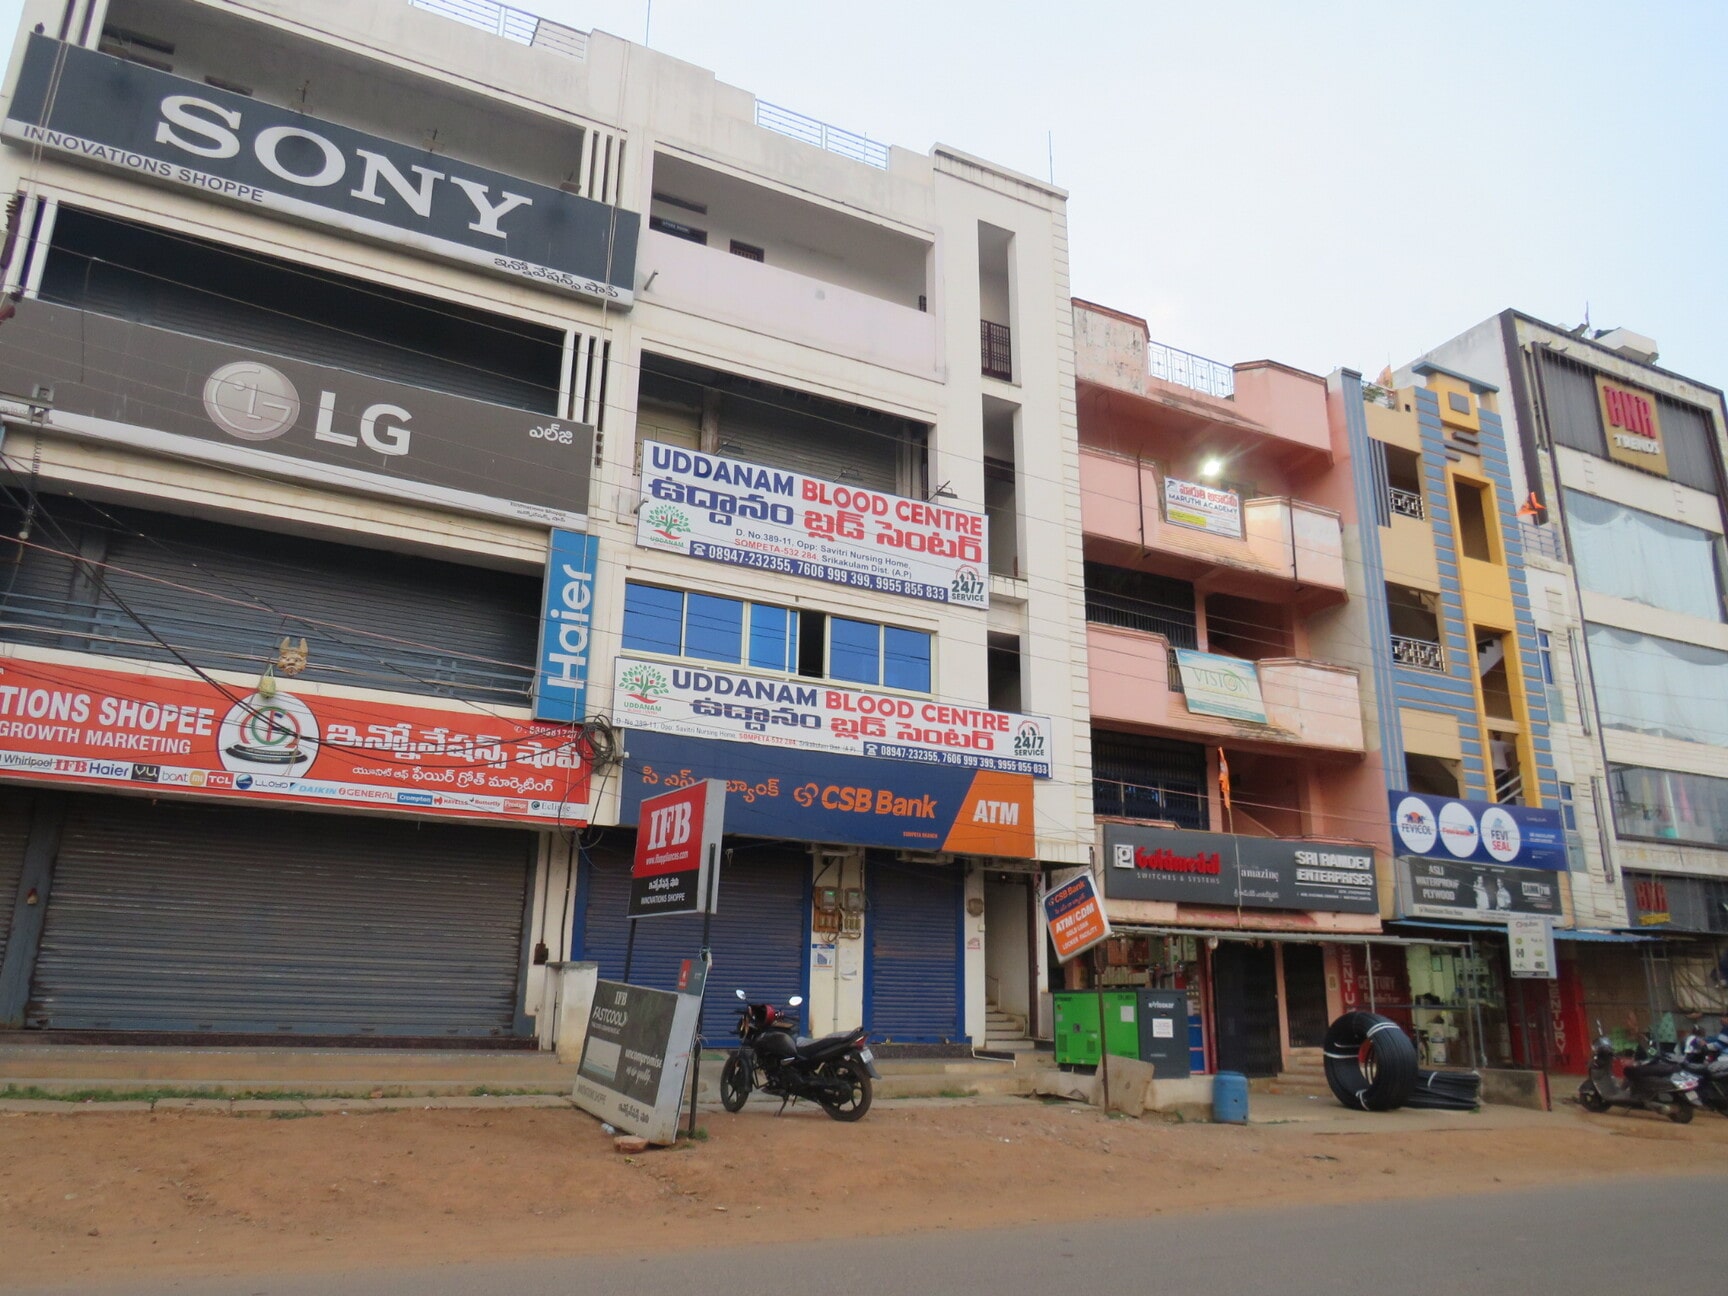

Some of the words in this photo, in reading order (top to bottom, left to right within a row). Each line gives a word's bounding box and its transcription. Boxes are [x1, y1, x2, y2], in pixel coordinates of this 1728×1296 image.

[23, 124, 172, 177] INNOVATIONS
[178, 168, 264, 203] SHOPPE
[156, 94, 533, 239] SONY
[315, 390, 413, 456] LG
[652, 445, 794, 497] UDDANAM
[801, 478, 889, 517] BLOOD
[895, 500, 983, 537] CENTRE
[1168, 493, 1202, 506] MARUTHI
[1203, 501, 1238, 514] ACADEMY
[648, 476, 794, 526] ఉద్దానం
[803, 510, 865, 542] బ్లడ్
[875, 519, 982, 564] సెంటర్
[736, 528, 745, 537] D.
[797, 540, 818, 552] Opp:
[820, 544, 848, 557] Savitri
[851, 550, 883, 566] Nursing
[708, 545, 794, 574] 08947-232355,
[798, 561, 824, 578] 7606
[828, 567, 847, 583] 999
[850, 572, 873, 589] 399,
[876, 578, 902, 594] 9955
[904, 585, 923, 597] 855
[926, 588, 945, 601] 833
[822, 555, 869, 571] Srikakulam
[871, 564, 890, 575] Dist.
[892, 568, 912, 580] (A.P)
[951, 580, 984, 595] 24/7
[951, 592, 984, 602] SERVICE
[547, 563, 592, 690] Haier
[0, 685, 91, 723] TIONS
[98, 697, 215, 736] SHOPEE
[623, 701, 662, 712] UDDANAM
[673, 669, 818, 707] UDDANAM
[825, 690, 914, 719] BLOOD
[921, 703, 1010, 732] CENTRE
[675, 725, 695, 734] Savitri
[696, 727, 718, 737] Nursing
[689, 697, 822, 732] ఉద్దానం
[830, 716, 886, 741] బ్లడ్
[896, 721, 995, 751] సెంటర్
[0, 721, 80, 743] GROWTH
[85, 730, 192, 755] MARKETING
[1013, 736, 1045, 749] 24/7
[881, 745, 940, 763] 08947-232355,
[942, 752, 962, 764] 7606
[963, 754, 978, 766] 999
[979, 757, 997, 770] 399,
[997, 759, 1017, 772] 9955
[1017, 762, 1032, 773] 855
[1013, 749, 1045, 757] SERVICE
[5, 754, 53, 768] Whirlpool
[54, 758, 88, 773] IFB
[89, 762, 129, 777] Haier
[208, 775, 232, 784] TCL
[255, 780, 288, 788] LLOYD
[299, 785, 337, 794] DAIKIN
[347, 788, 396, 800] GENERAL
[399, 794, 432, 804] Crompton
[542, 802, 571, 812] Eclipse
[642, 765, 659, 785] సి
[821, 785, 873, 813] CSB
[875, 790, 938, 819] Bank
[972, 799, 1019, 826] ATM
[647, 801, 692, 850] IFB
[1401, 823, 1433, 836] FEVICOL
[1491, 829, 1508, 841] FEVI
[1294, 851, 1318, 865] SRI
[1492, 840, 1511, 852] SEAL
[1137, 872, 1176, 881] SWITCHES
[1240, 868, 1279, 882] amazing
[1295, 868, 1373, 886] ENTERPRISES
[1056, 902, 1095, 935] ATM/CDM
[614, 991, 628, 1006] IFB
[592, 1006, 624, 1026] FASTCOOL
